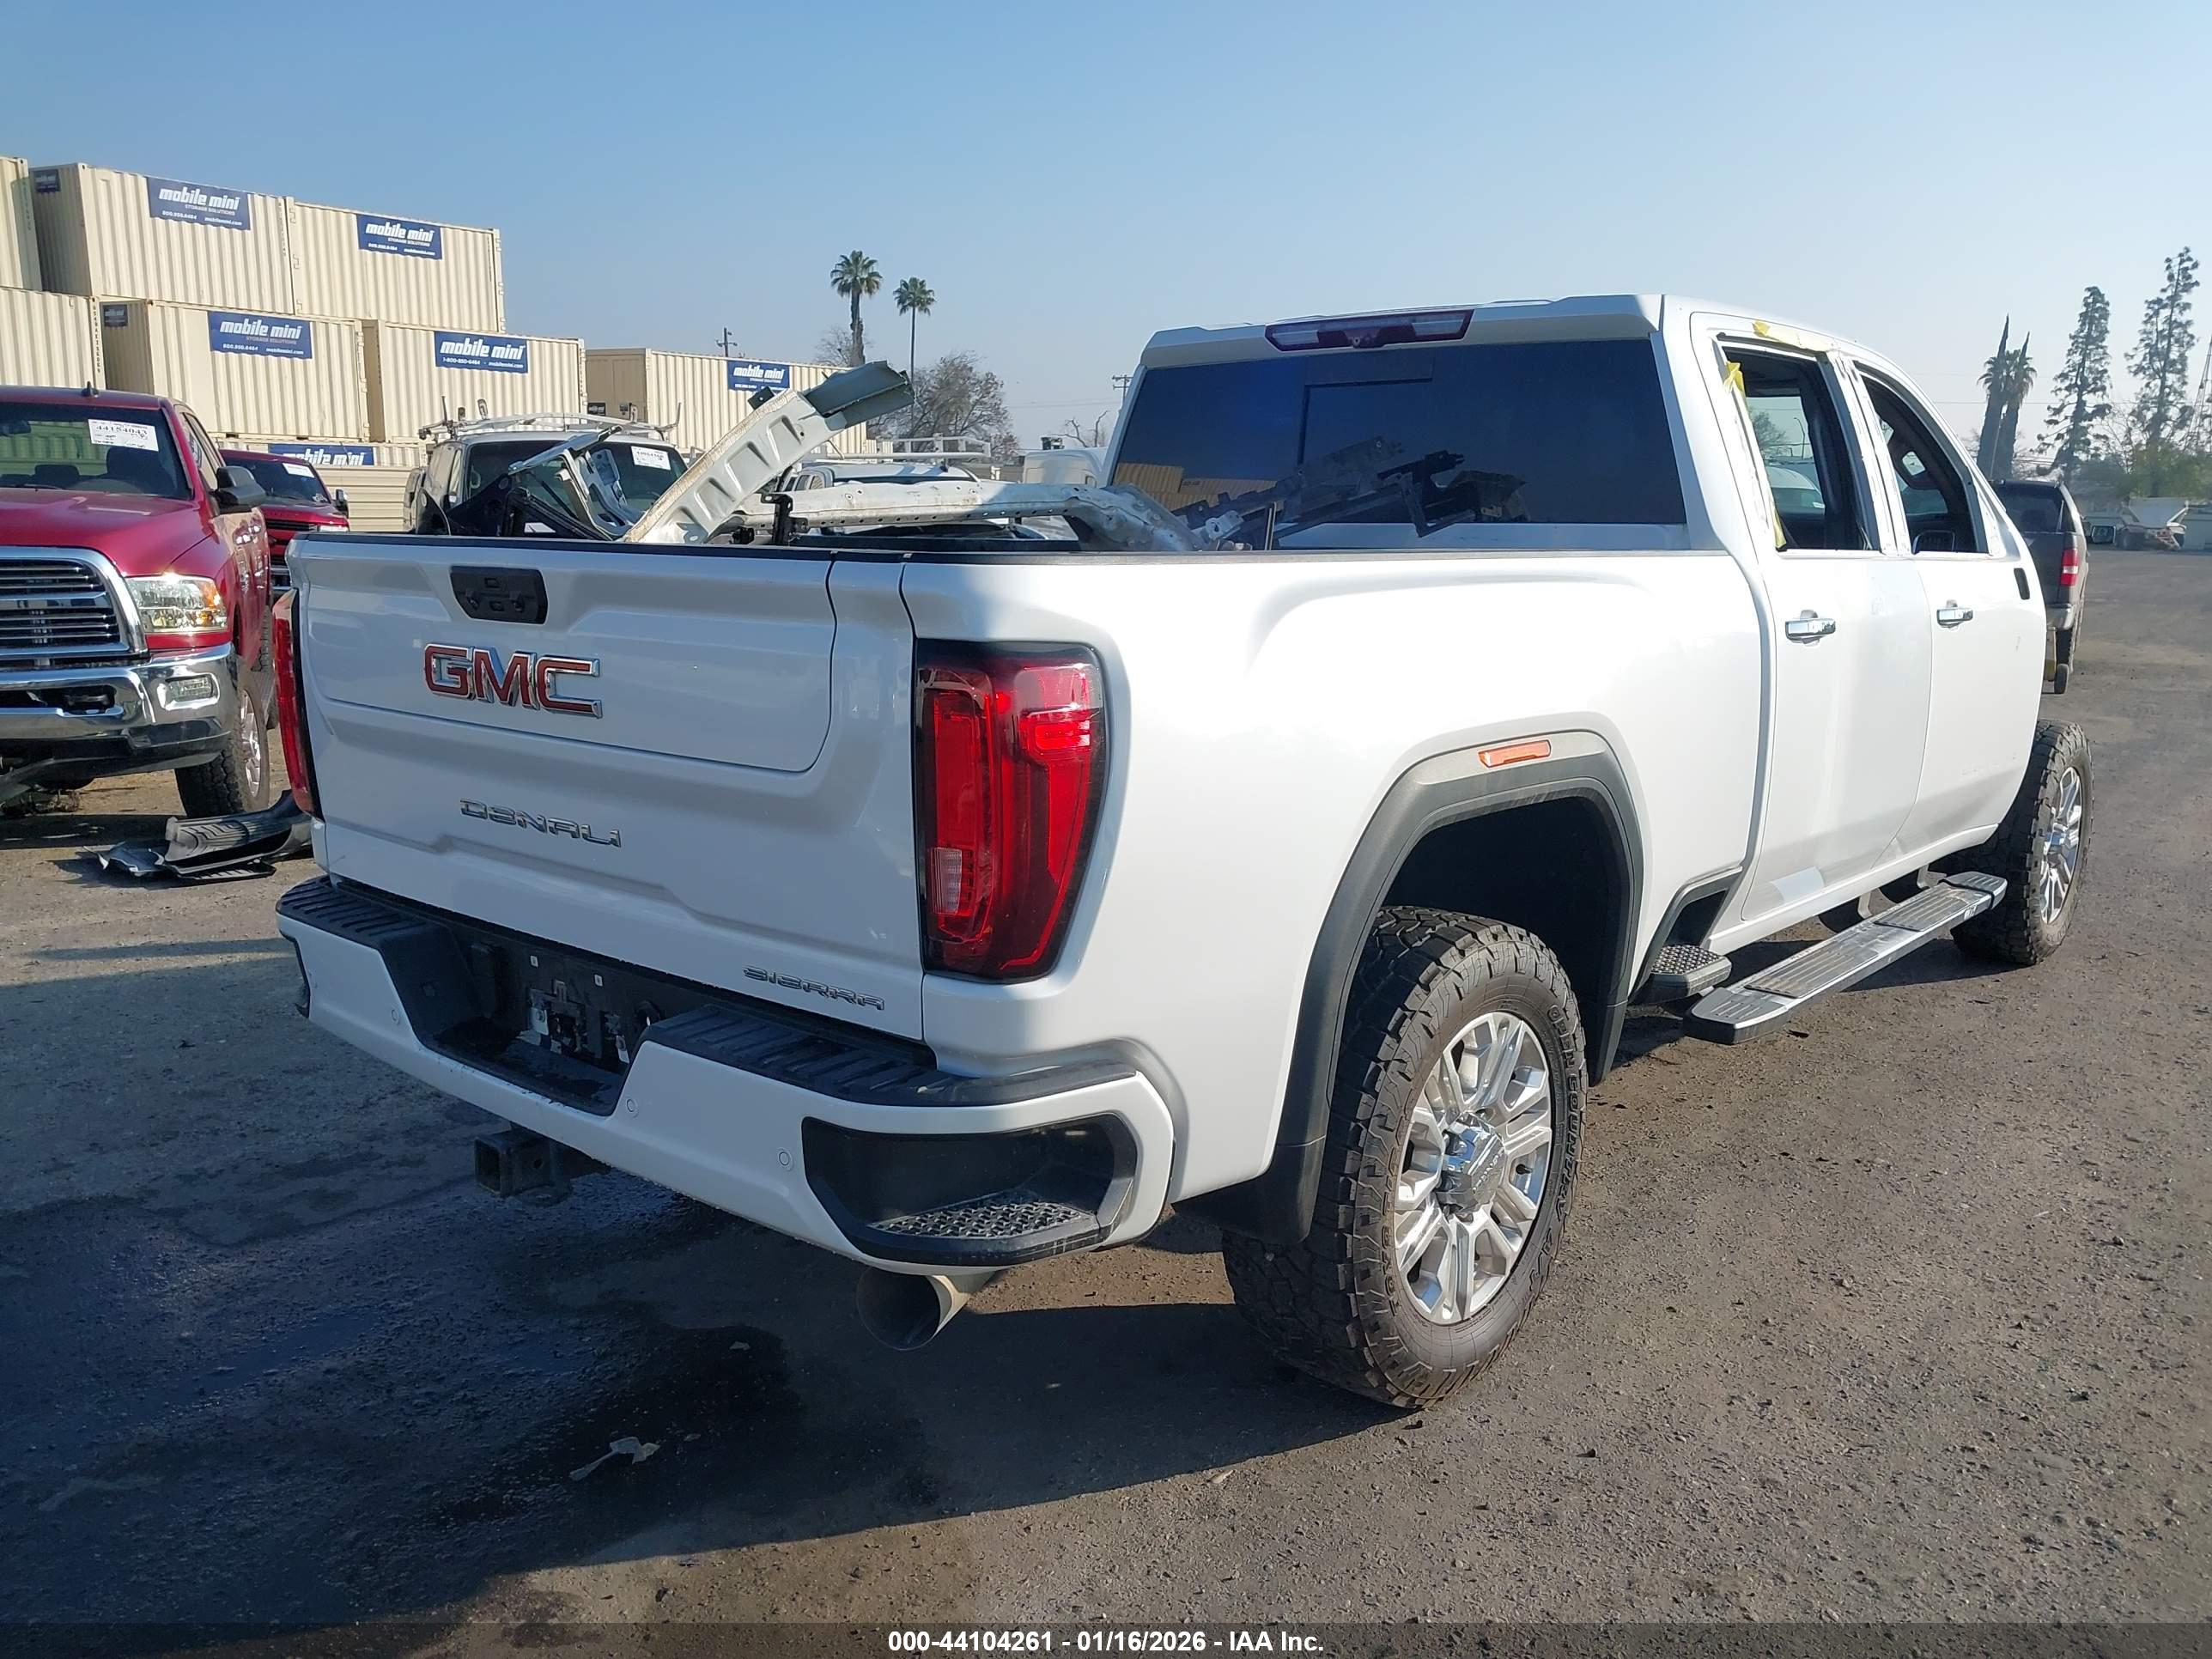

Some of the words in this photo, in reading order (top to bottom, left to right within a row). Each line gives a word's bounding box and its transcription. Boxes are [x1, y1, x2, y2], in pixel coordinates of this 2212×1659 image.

[158, 186, 208, 206] mobile
[209, 195, 240, 210] mini
[365, 222, 407, 239] mobile
[407, 228, 434, 242] mini
[219, 318, 269, 337] mobile
[270, 324, 302, 339] mini
[440, 337, 490, 357] mobile
[490, 343, 526, 360] mini
[733, 364, 764, 379] mobile
[763, 368, 785, 380] mini
[425, 642, 604, 720] GMC
[459, 798, 622, 848] DENALI
[743, 965, 885, 1011] SIERRA
